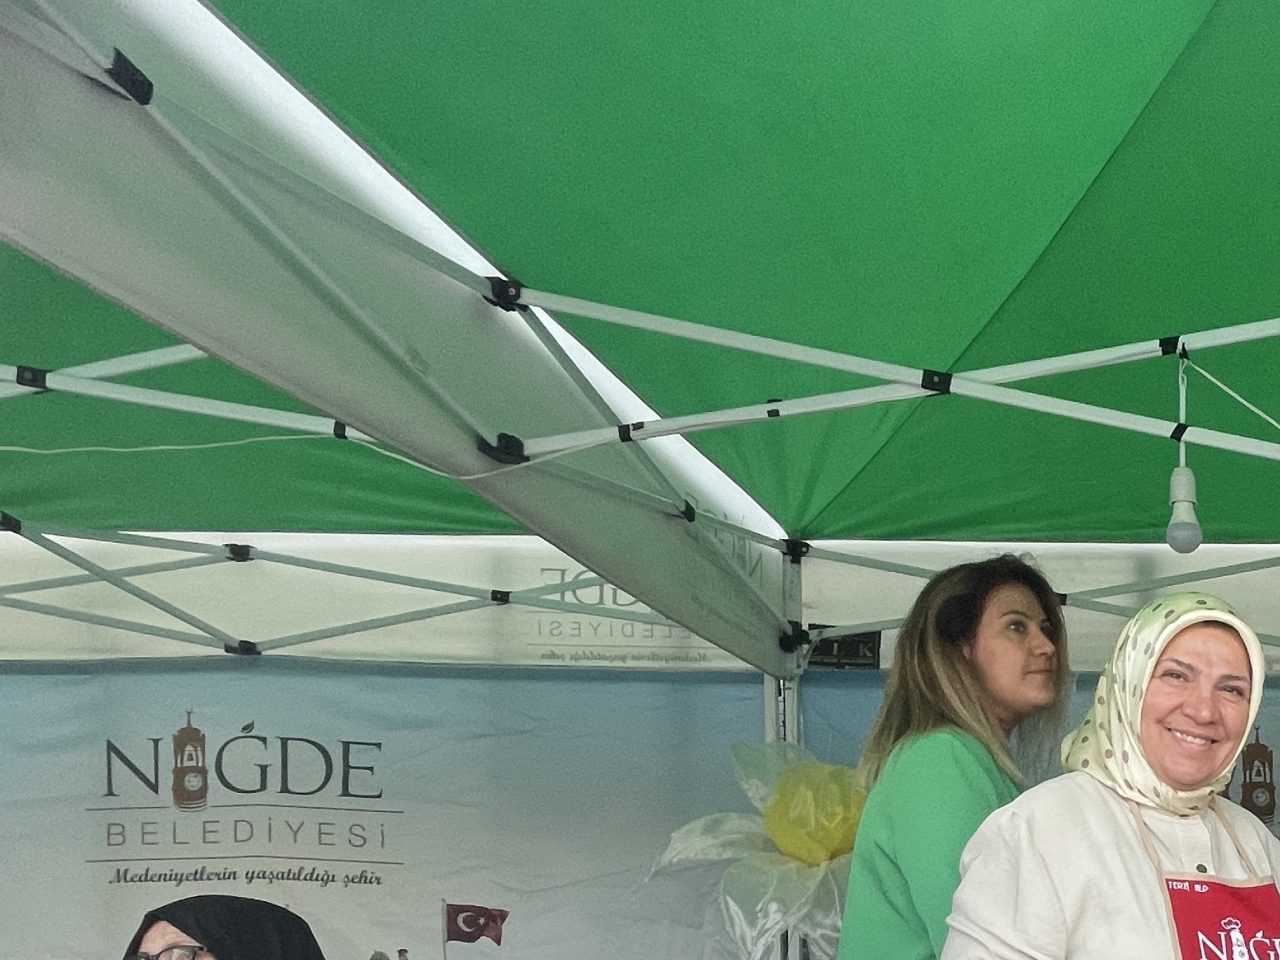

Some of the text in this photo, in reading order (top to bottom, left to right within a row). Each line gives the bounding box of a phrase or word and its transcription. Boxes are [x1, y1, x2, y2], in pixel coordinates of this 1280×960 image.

[107, 817, 386, 849] BELEDİYESİ
[108, 866, 384, 888] Medeniyetlerin yaşatıldığı şehir
